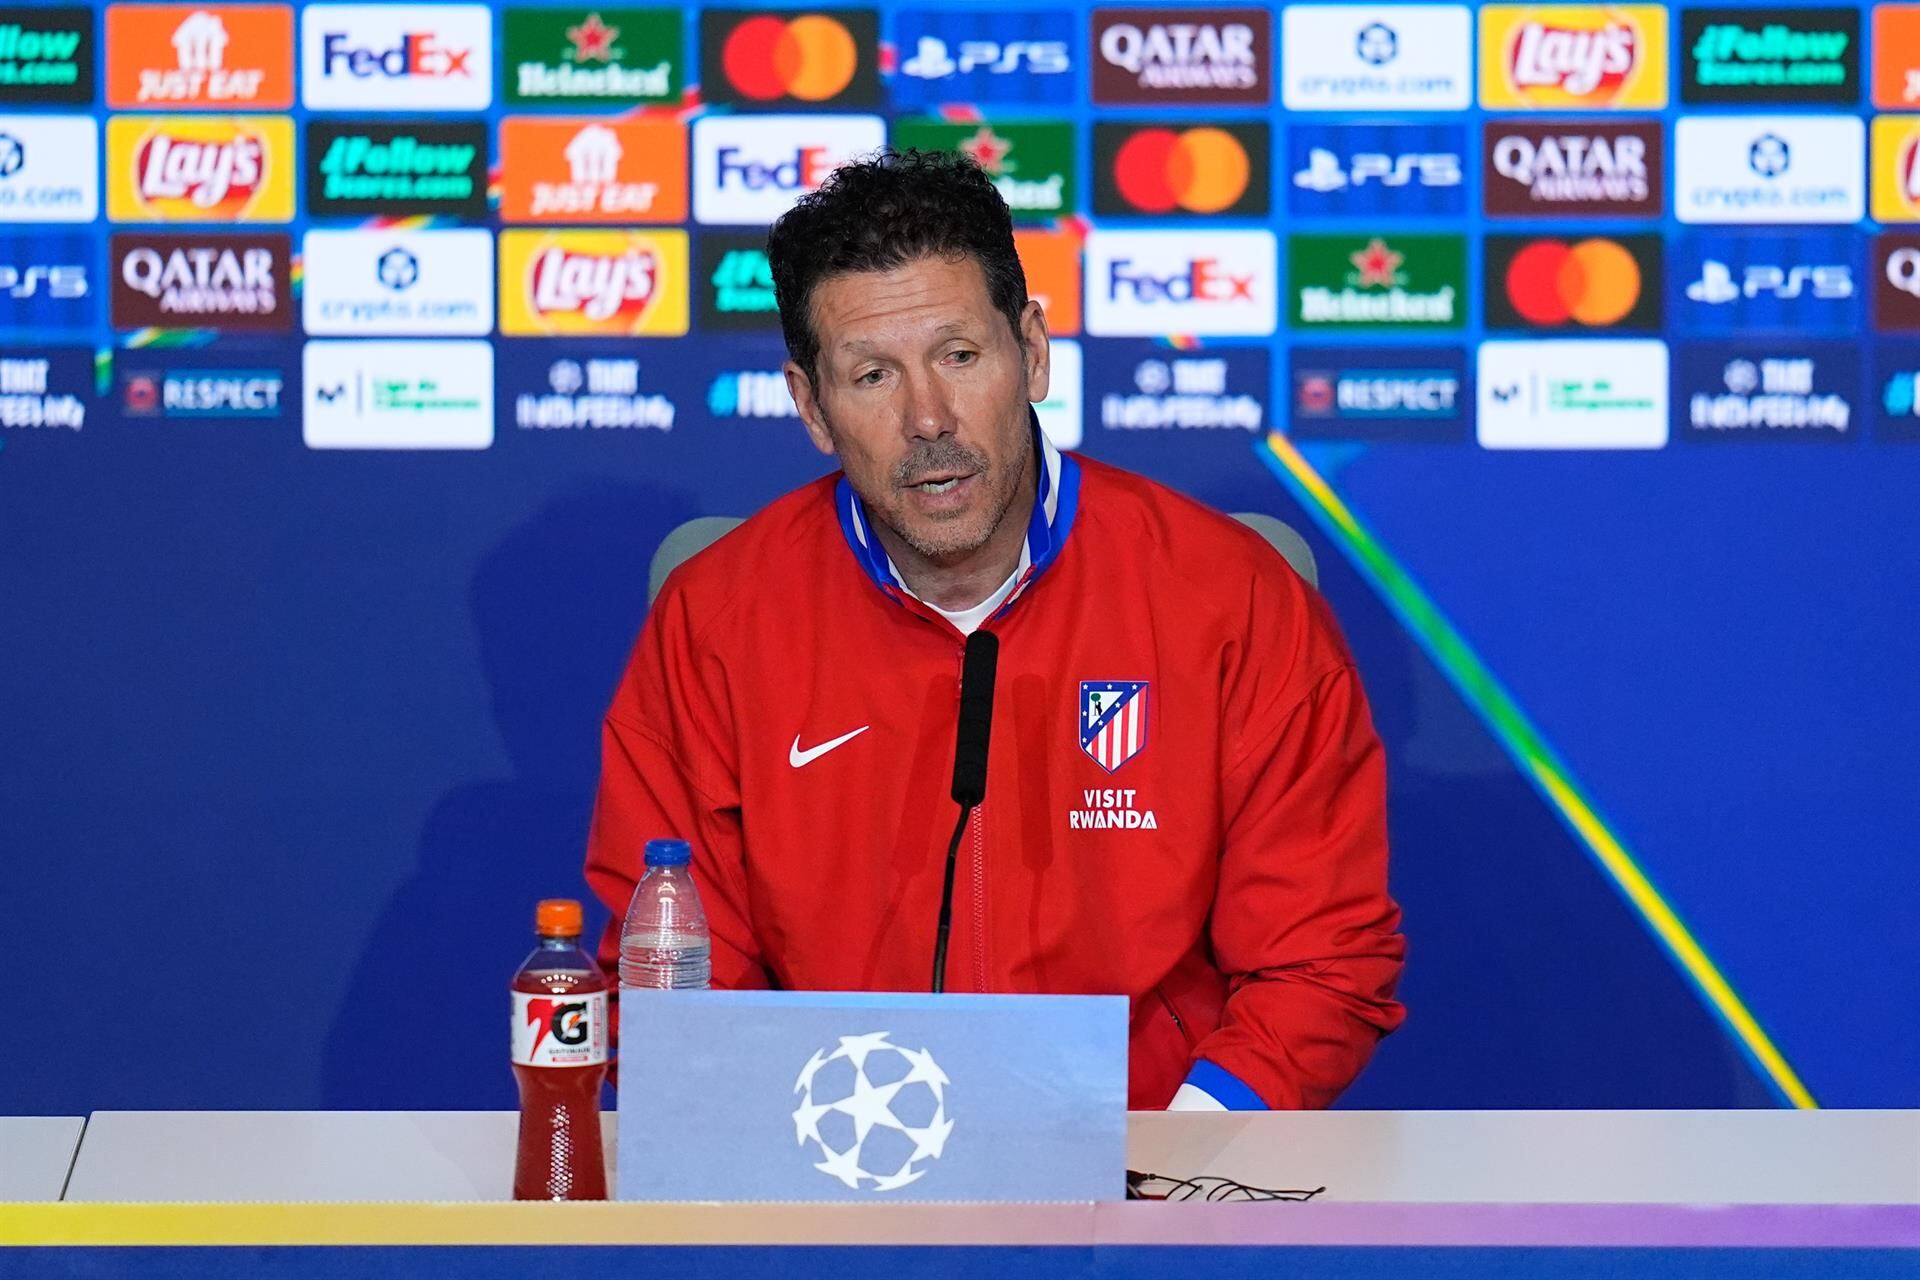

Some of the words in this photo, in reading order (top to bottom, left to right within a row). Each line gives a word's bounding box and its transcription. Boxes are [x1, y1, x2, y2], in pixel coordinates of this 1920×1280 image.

[322, 32, 473, 77] FedEx
[958, 41, 1070, 74] PS5
[1100, 23, 1255, 73] QATAR
[1513, 23, 1635, 96] Lay's
[137, 68, 203, 101] JUST
[208, 68, 265, 99] EAT
[518, 61, 671, 96] Heineken
[142, 135, 262, 208] Lay's
[717, 146, 838, 191] FedE
[1351, 152, 1461, 186] PS5
[1493, 135, 1647, 186] QATAR
[530, 182, 598, 216] JUST
[601, 182, 659, 213] EAT
[123, 248, 274, 297] QATAR
[537, 246, 656, 321] Lay's
[1109, 258, 1257, 304] FedEx
[1743, 265, 1854, 299] PS5
[1301, 286, 1455, 322] Heineken
[163, 379, 283, 410] RESPECT
[1337, 379, 1457, 410] RESPECT
[1084, 789, 1136, 808] VISIT
[1070, 811, 1157, 829] RWANDA
